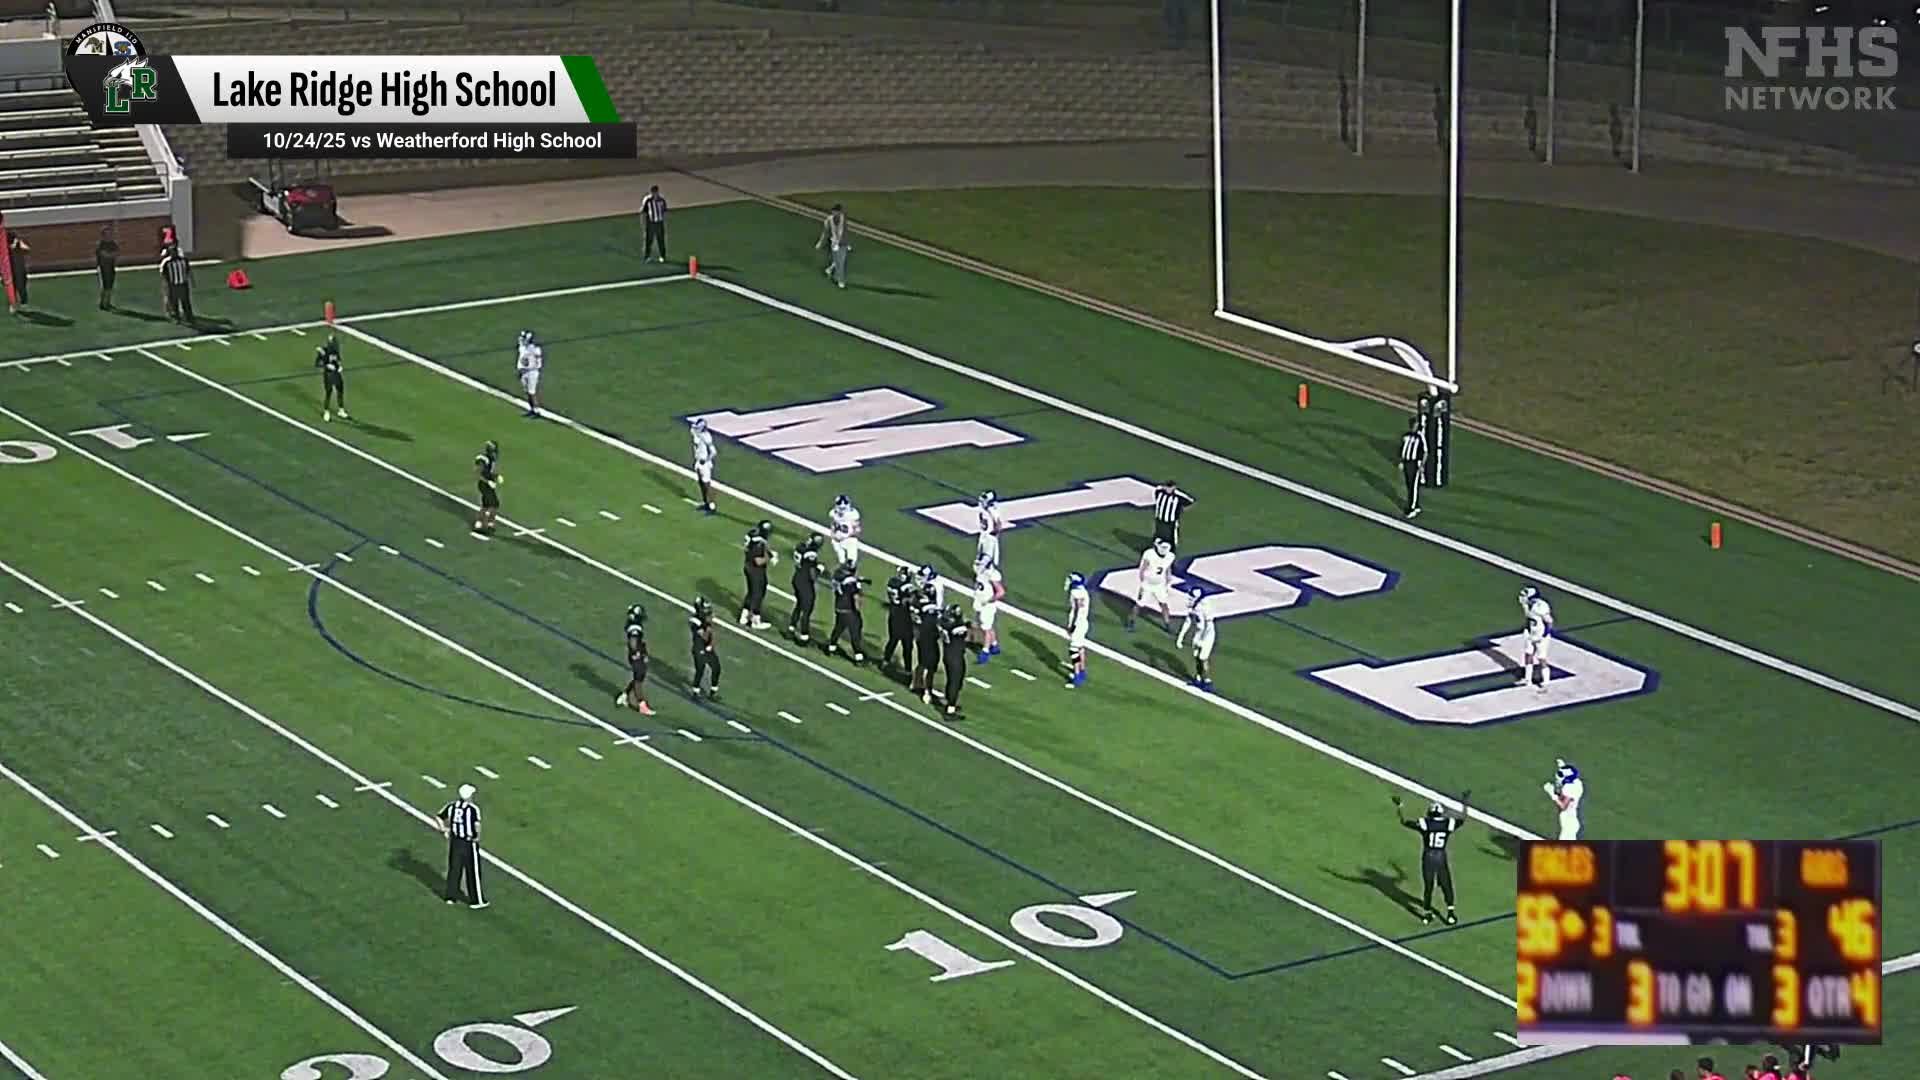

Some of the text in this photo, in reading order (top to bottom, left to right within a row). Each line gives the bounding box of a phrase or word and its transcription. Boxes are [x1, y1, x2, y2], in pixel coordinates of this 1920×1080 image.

[453, 808, 465, 824] R
[1663, 840, 1757, 911] 3:07
[884, 903, 1124, 983] 10
[1591, 906, 1612, 957] 3
[1776, 910, 1797, 959] 3
[1828, 898, 1876, 959] 46
[1626, 962, 1655, 1025] 3
[1657, 973, 1681, 1014] TO
[1685, 973, 1713, 1016] GO
[1773, 965, 1800, 1028] 3
[1851, 969, 1879, 1026] 4
